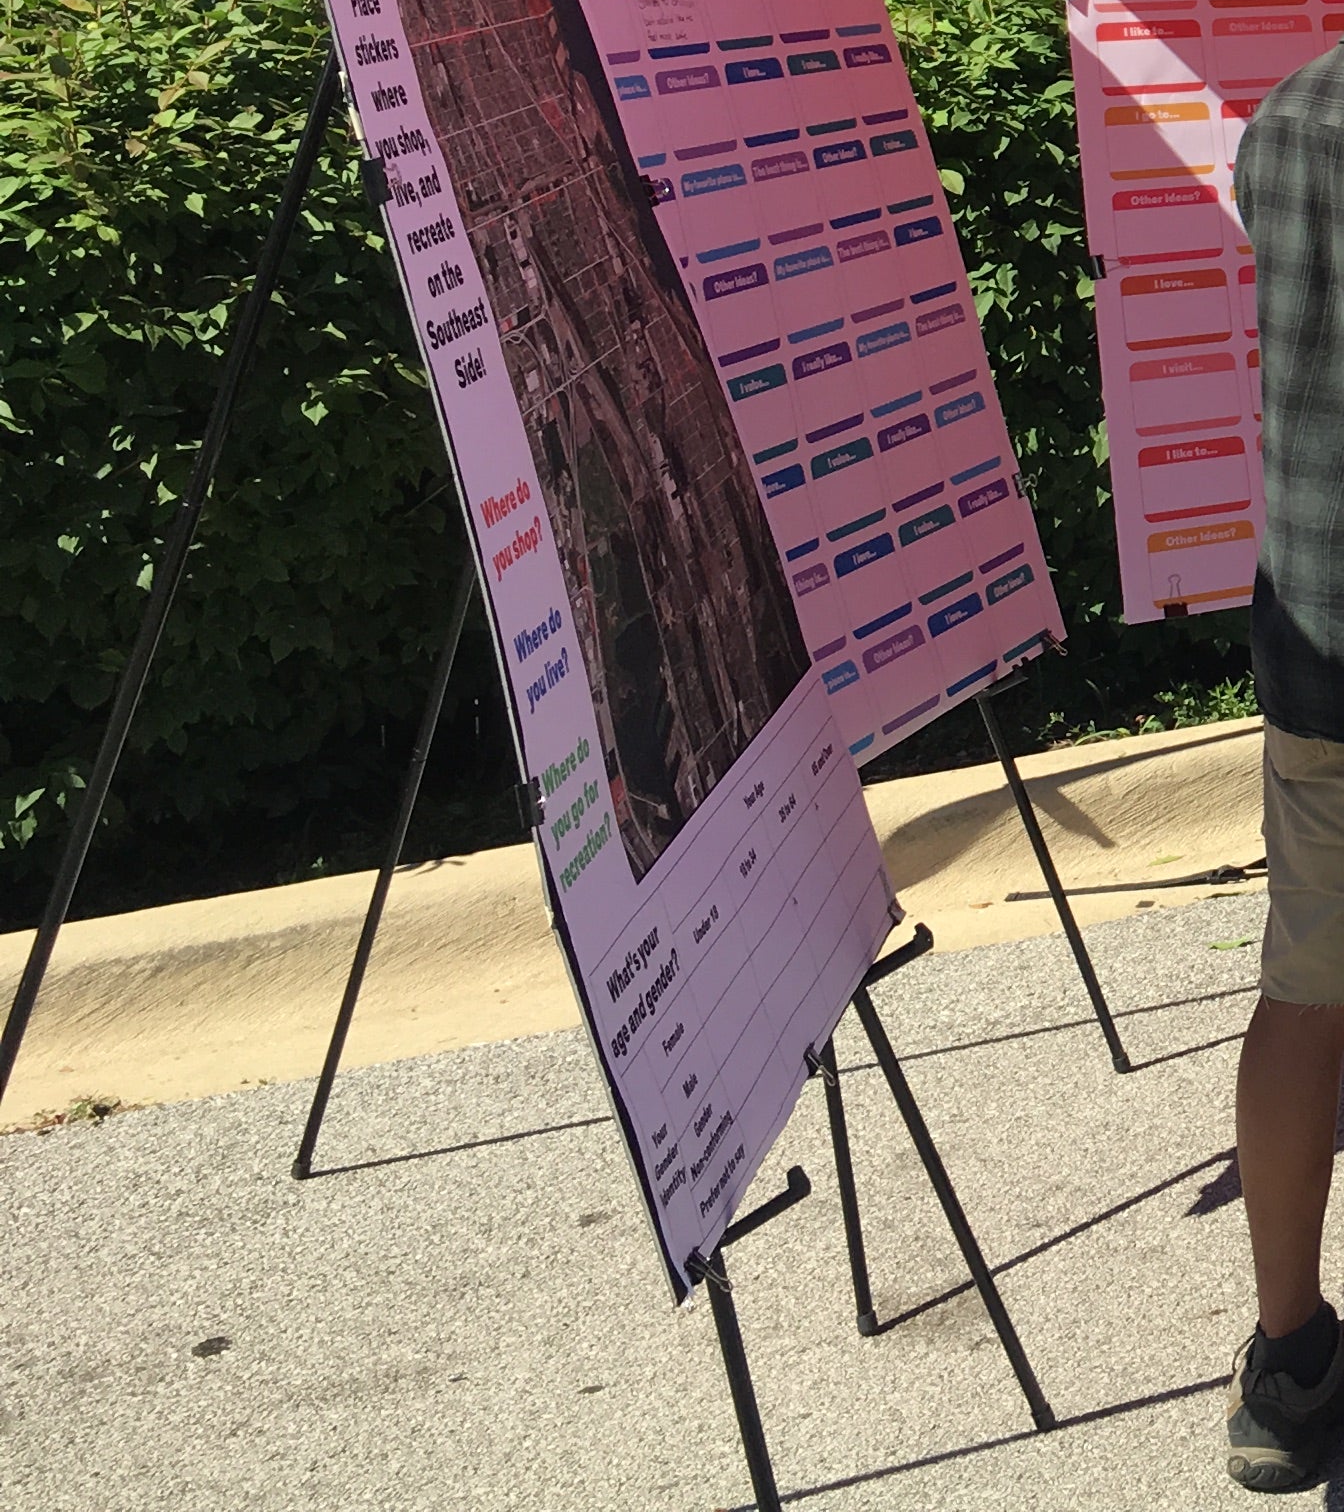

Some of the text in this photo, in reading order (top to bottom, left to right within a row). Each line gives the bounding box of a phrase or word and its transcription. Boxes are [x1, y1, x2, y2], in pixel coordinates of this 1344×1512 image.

[1129, 26, 1150, 37] like
[1229, 22, 1260, 32] Other
[355, 33, 399, 66] stickers
[371, 81, 408, 112] where
[1157, 110, 1180, 119] to...
[375, 125, 432, 160] you shop,
[392, 166, 442, 207] live, and
[1130, 194, 1162, 206] Other
[406, 213, 455, 255] recreate
[427, 260, 464, 298] on the
[426, 297, 488, 350] Southeast
[454, 347, 487, 389] Side!
[1172, 449, 1194, 459] like
[480, 477, 531, 528] Where do
[492, 516, 543, 582] you shop?
[1165, 535, 1197, 546] Other
[513, 606, 562, 663] Where do
[526, 647, 569, 715] you live?
[541, 737, 590, 796] Where do
[550, 779, 599, 851] you go for
[559, 812, 612, 892] recreation?
[693, 904, 719, 944] Under 18
[606, 926, 660, 1003] What's your
[610, 947, 680, 1058] age and gender?
[662, 1022, 684, 1057] Female
[682, 1073, 698, 1099] Male
[651, 1123, 668, 1149] Your
[694, 1103, 712, 1138] Gender
[655, 1143, 678, 1181] Gender
[699, 1144, 746, 1218] Prefer not to say
[659, 1166, 687, 1209] Identity
